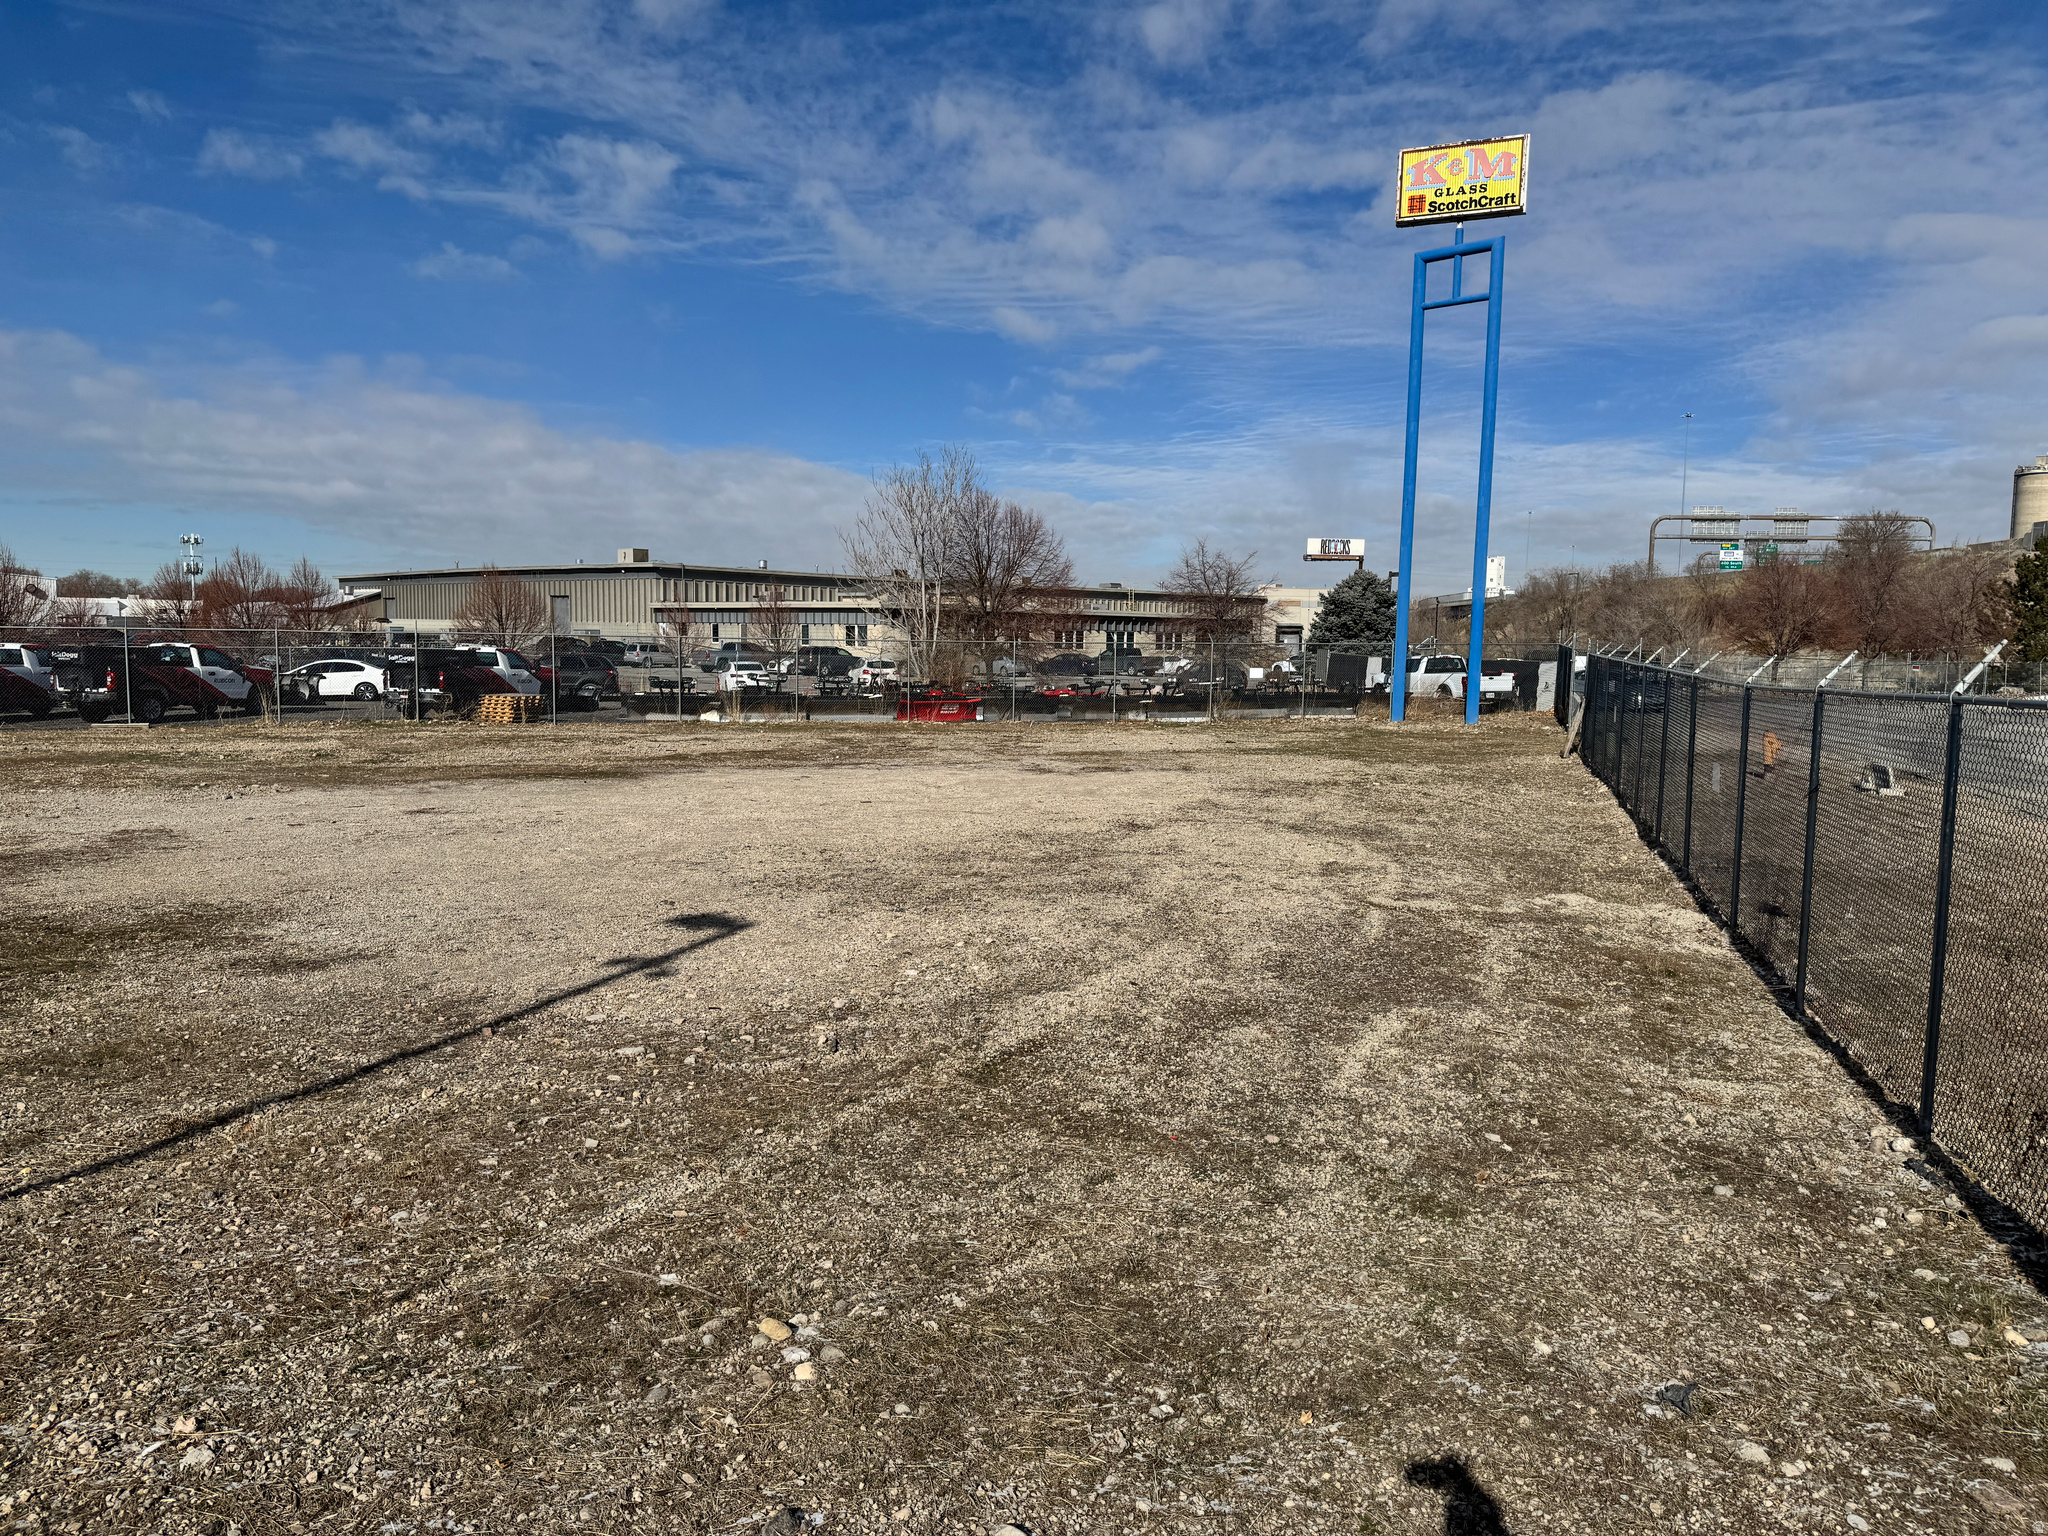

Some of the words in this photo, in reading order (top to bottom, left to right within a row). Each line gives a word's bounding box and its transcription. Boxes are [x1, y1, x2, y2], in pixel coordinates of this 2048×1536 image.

[1406, 152, 1449, 190] K
[1448, 158, 1464, 176] &
[1464, 148, 1518, 184] M
[1434, 184, 1488, 198] GLASS
[1428, 193, 1517, 213] ScotchCraft
